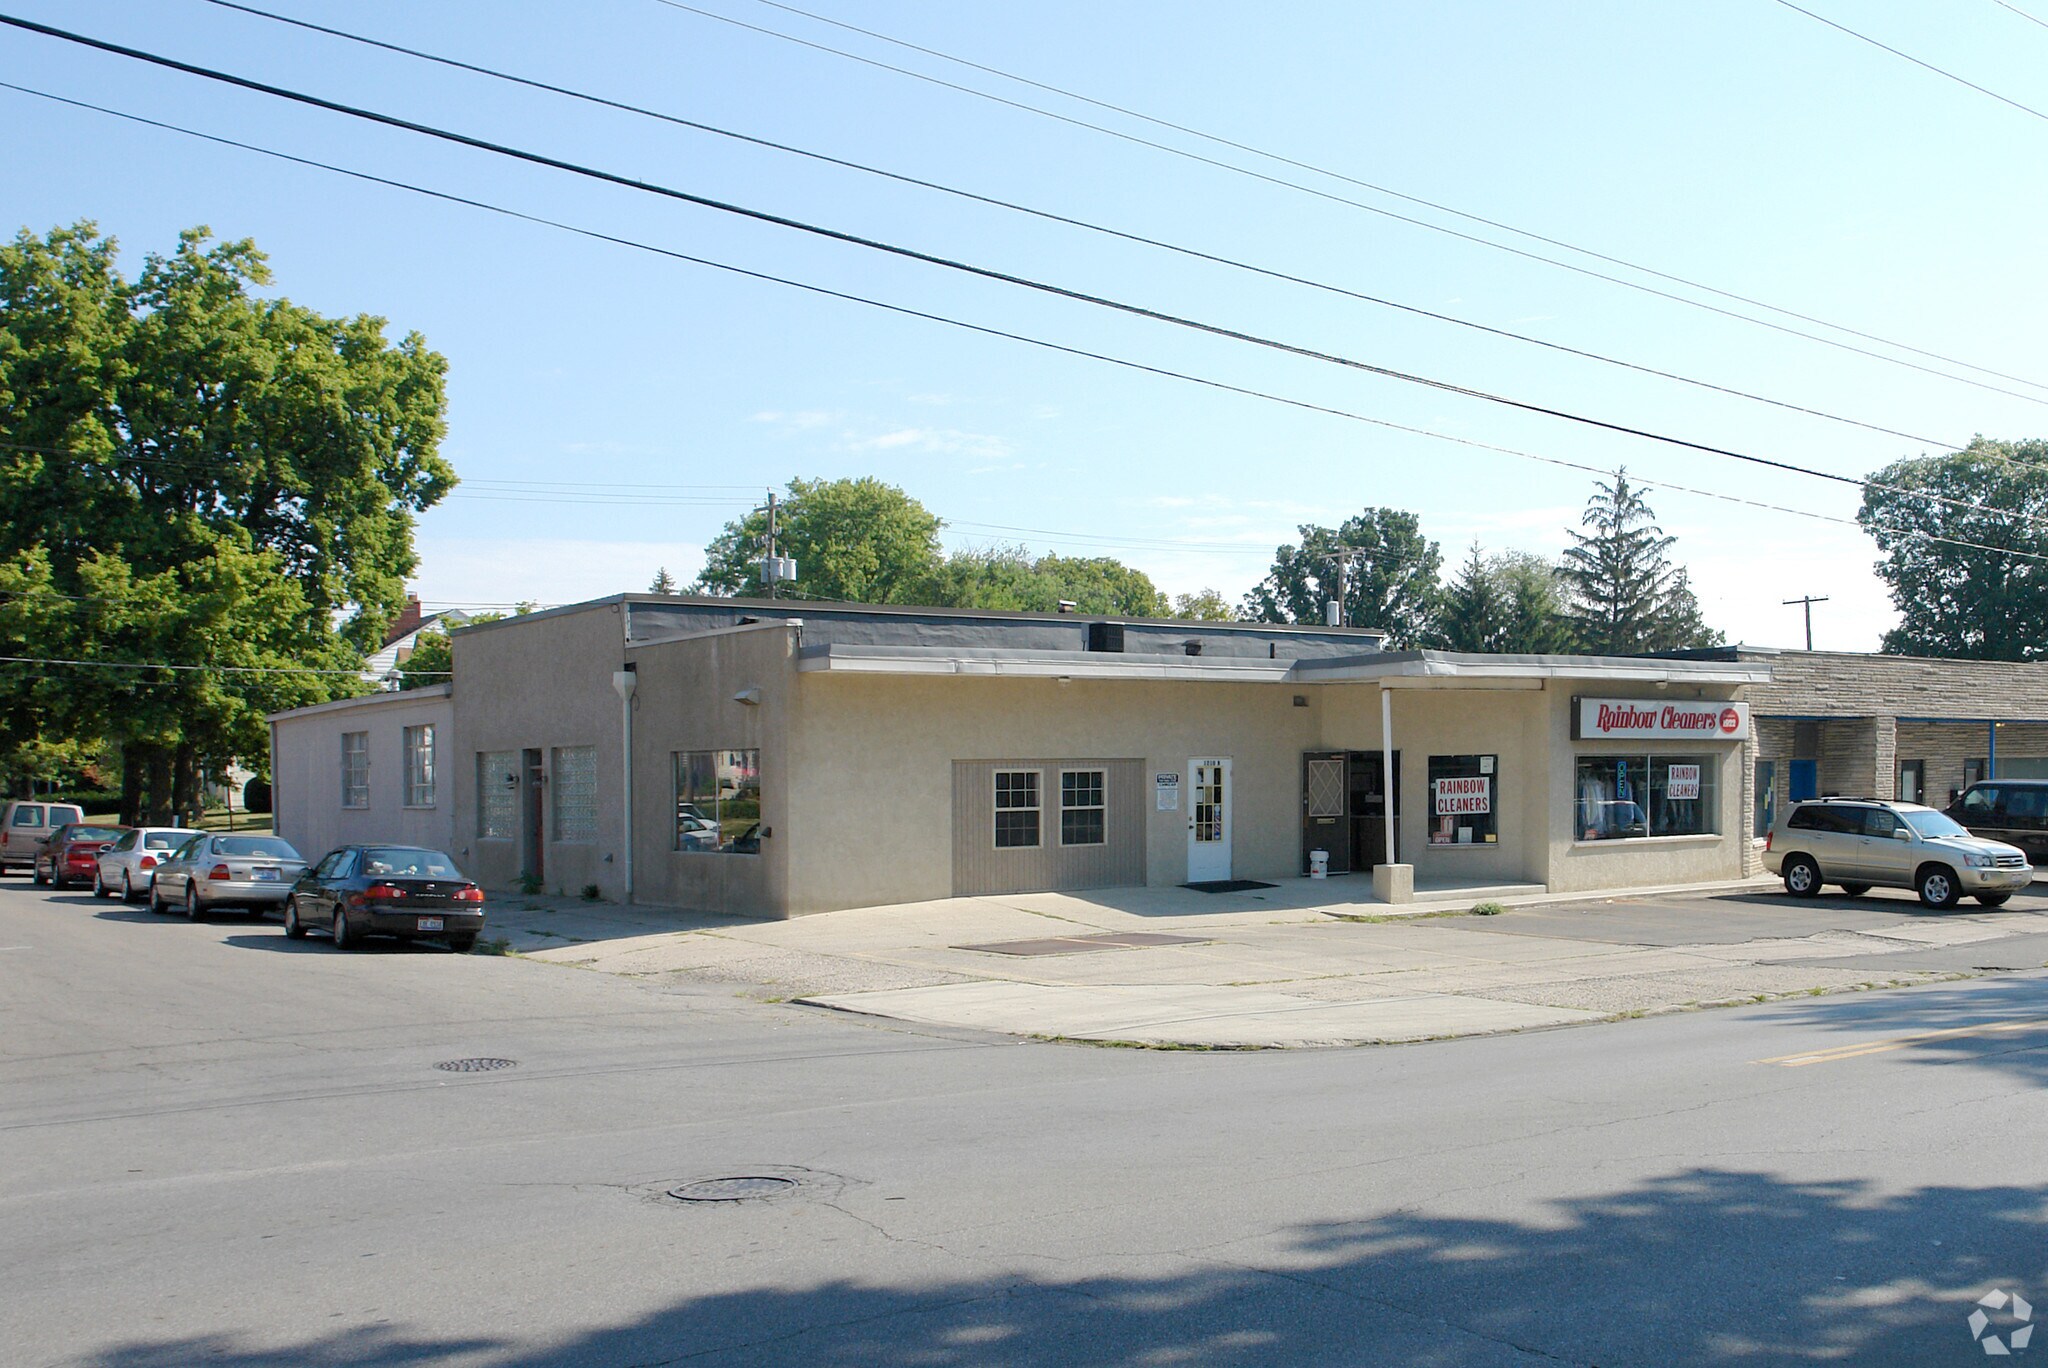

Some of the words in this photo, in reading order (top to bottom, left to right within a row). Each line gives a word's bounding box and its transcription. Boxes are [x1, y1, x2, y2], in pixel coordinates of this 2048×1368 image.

[1596, 704, 1657, 732] Rainbow
[1660, 706, 1716, 729] Cleaners
[1617, 763, 1625, 797] OPEN
[1671, 767, 1697, 780] RAINBOW
[1440, 779, 1485, 794] RAINBOW
[1669, 784, 1698, 797] CLEANERS
[1438, 797, 1488, 812] CLEANERS
